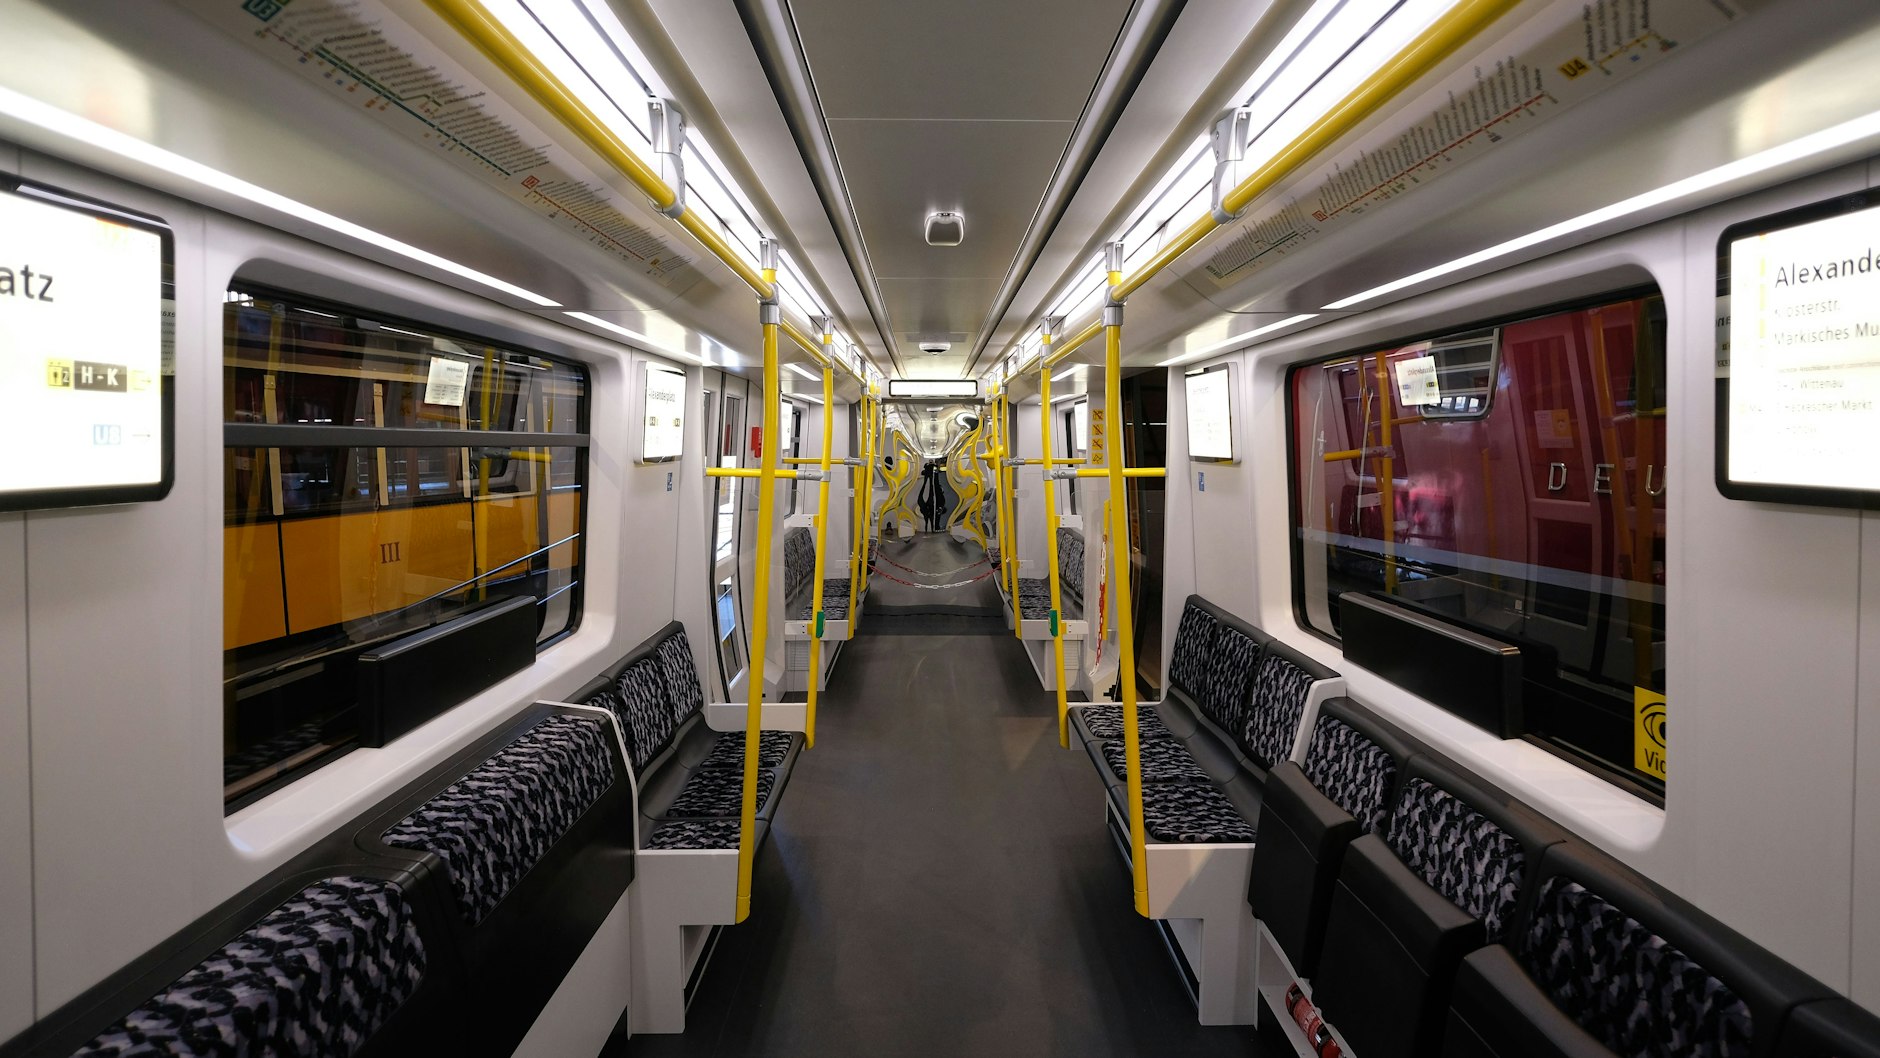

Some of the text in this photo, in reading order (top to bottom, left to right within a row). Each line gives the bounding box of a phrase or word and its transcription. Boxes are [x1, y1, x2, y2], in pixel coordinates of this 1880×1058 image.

[1560, 58, 1587, 78] U4
[0, 264, 54, 302] atz
[380, 541, 400, 564] III
